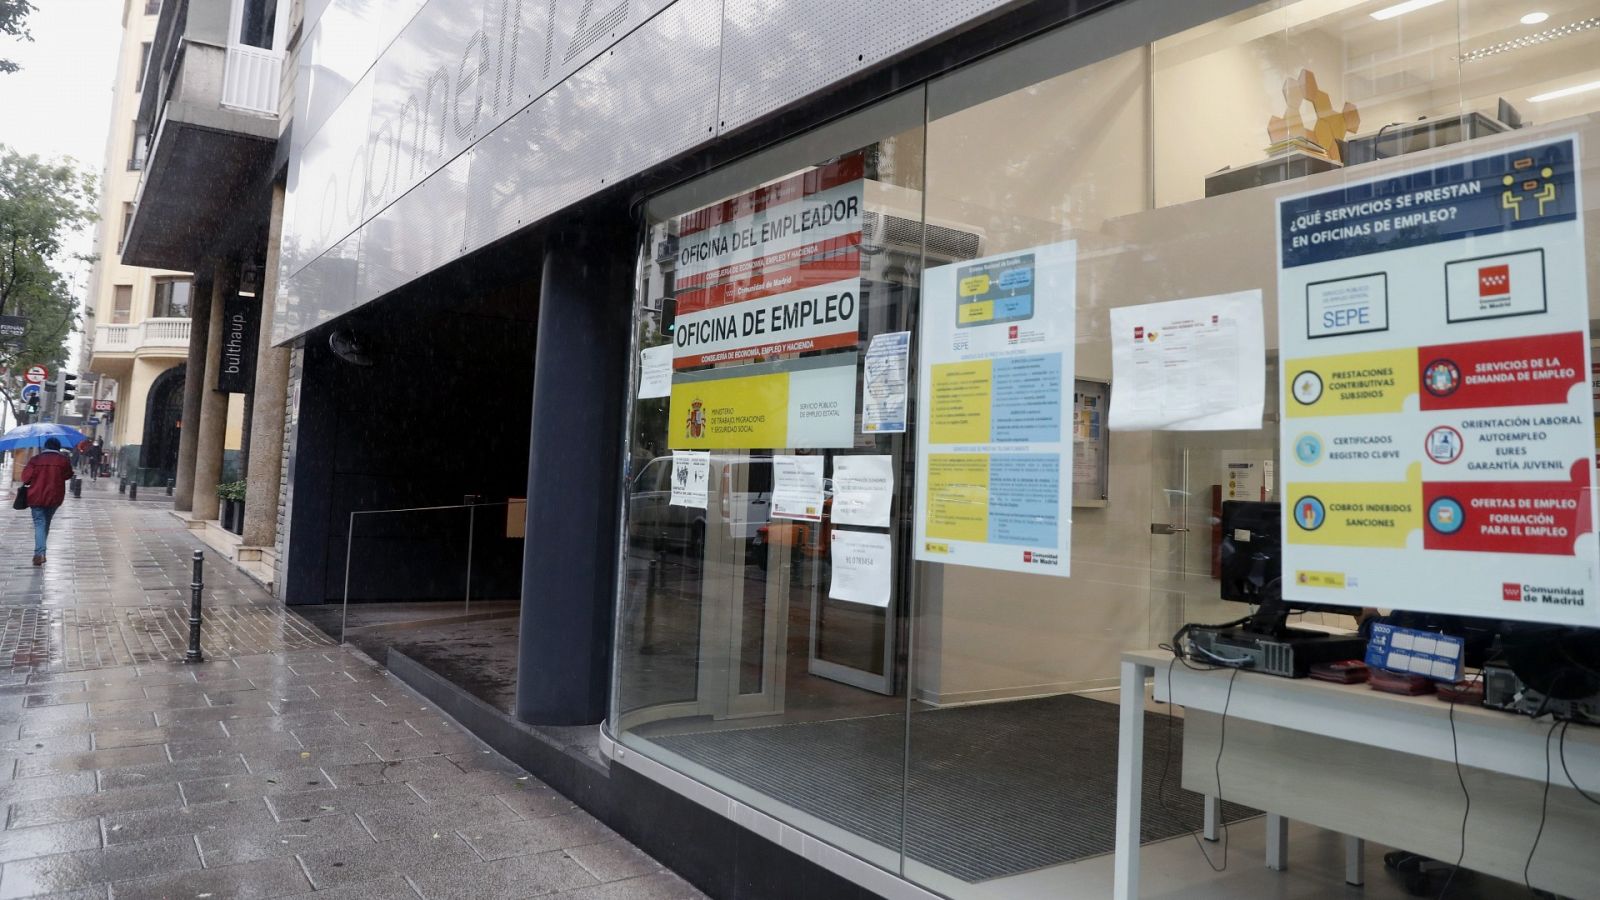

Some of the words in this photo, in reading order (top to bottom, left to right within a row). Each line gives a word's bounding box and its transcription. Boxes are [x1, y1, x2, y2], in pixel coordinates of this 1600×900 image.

[1290, 209, 1322, 232] ¿QUÉ
[1324, 199, 1392, 223] SERVICIOS
[1396, 196, 1412, 209] SE
[1414, 180, 1481, 206] PRESTAN
[681, 235, 728, 266] OFICINA
[733, 228, 757, 250] DEL
[761, 195, 858, 243] EMPLEADOR
[1292, 234, 1308, 248] EN
[1311, 223, 1371, 245] OFICINAS
[1374, 218, 1391, 232] DE
[1394, 207, 1457, 230] EMPLEO?
[733, 265, 740, 274] DE
[765, 254, 786, 265] EMPLEO
[791, 245, 818, 259] HACIENDA
[737, 283, 765, 295] Comunidad
[765, 281, 773, 290] de
[773, 276, 792, 287] Madrid
[677, 315, 737, 348] OFICINA
[742, 308, 766, 337] DE
[770, 291, 856, 334] EMPLEO
[1323, 306, 1370, 328] SEPE
[225, 314, 247, 374] bulthaup
[953, 342, 969, 350] SEPE
[701, 352, 728, 363] CONSEJERÍA
[728, 351, 735, 360] DE
[735, 347, 761, 359] ECONOMÍA,
[762, 345, 781, 355] EMPLEO
[781, 344, 787, 352] Y
[787, 341, 814, 352] HACIENDA
[1474, 359, 1528, 373] SERVICIOS
[1530, 358, 1543, 369] DE
[1546, 357, 1561, 369] LA
[1332, 367, 1393, 379] PRESTACIONES
[1465, 371, 1516, 385] DEMANDA
[1516, 370, 1529, 381] DE
[1532, 368, 1576, 380] EMPLEO
[1329, 379, 1395, 391] CONTRIBUTIVAS
[1340, 389, 1384, 400] SUBSIDIOS
[711, 407, 734, 416] MINISTERIO
[800, 402, 818, 410] SERVICIO
[806, 410, 822, 418] EMPLEO
[823, 409, 840, 417] ESTATAL
[711, 417, 716, 425] DE
[736, 415, 765, 424] MIGRACIONES
[1461, 416, 1531, 430] ORIENTACIÓN
[1533, 415, 1583, 426] LABORAL
[738, 425, 754, 433] SOCIAL
[1333, 435, 1393, 445] CERTIFICADOS
[1478, 432, 1547, 443] AUTOEMPLEO
[1329, 450, 1370, 460] REGISTRO
[1371, 449, 1401, 460] CL@VE
[1495, 447, 1527, 456] EURES
[1467, 460, 1519, 471] GARANTÍA
[1521, 460, 1564, 470] JUVENIL
[1329, 503, 1364, 512] COBROS
[1365, 503, 1412, 513] INDEBIDOS
[1470, 498, 1515, 509] OFERTAS
[1517, 498, 1532, 509] DE
[1533, 499, 1577, 510] EMPLEO
[1345, 518, 1395, 528] SANCIONES
[1489, 512, 1554, 524] FORMACIÓN
[1481, 525, 1510, 536] PARA
[1511, 526, 1523, 536] EL
[1525, 526, 1568, 537] EMPLEO
[1523, 584, 1584, 597] Comunidad
[1523, 593, 1538, 603] de
[1541, 595, 1584, 606] Madrid
[1373, 626, 1391, 634] 2020
